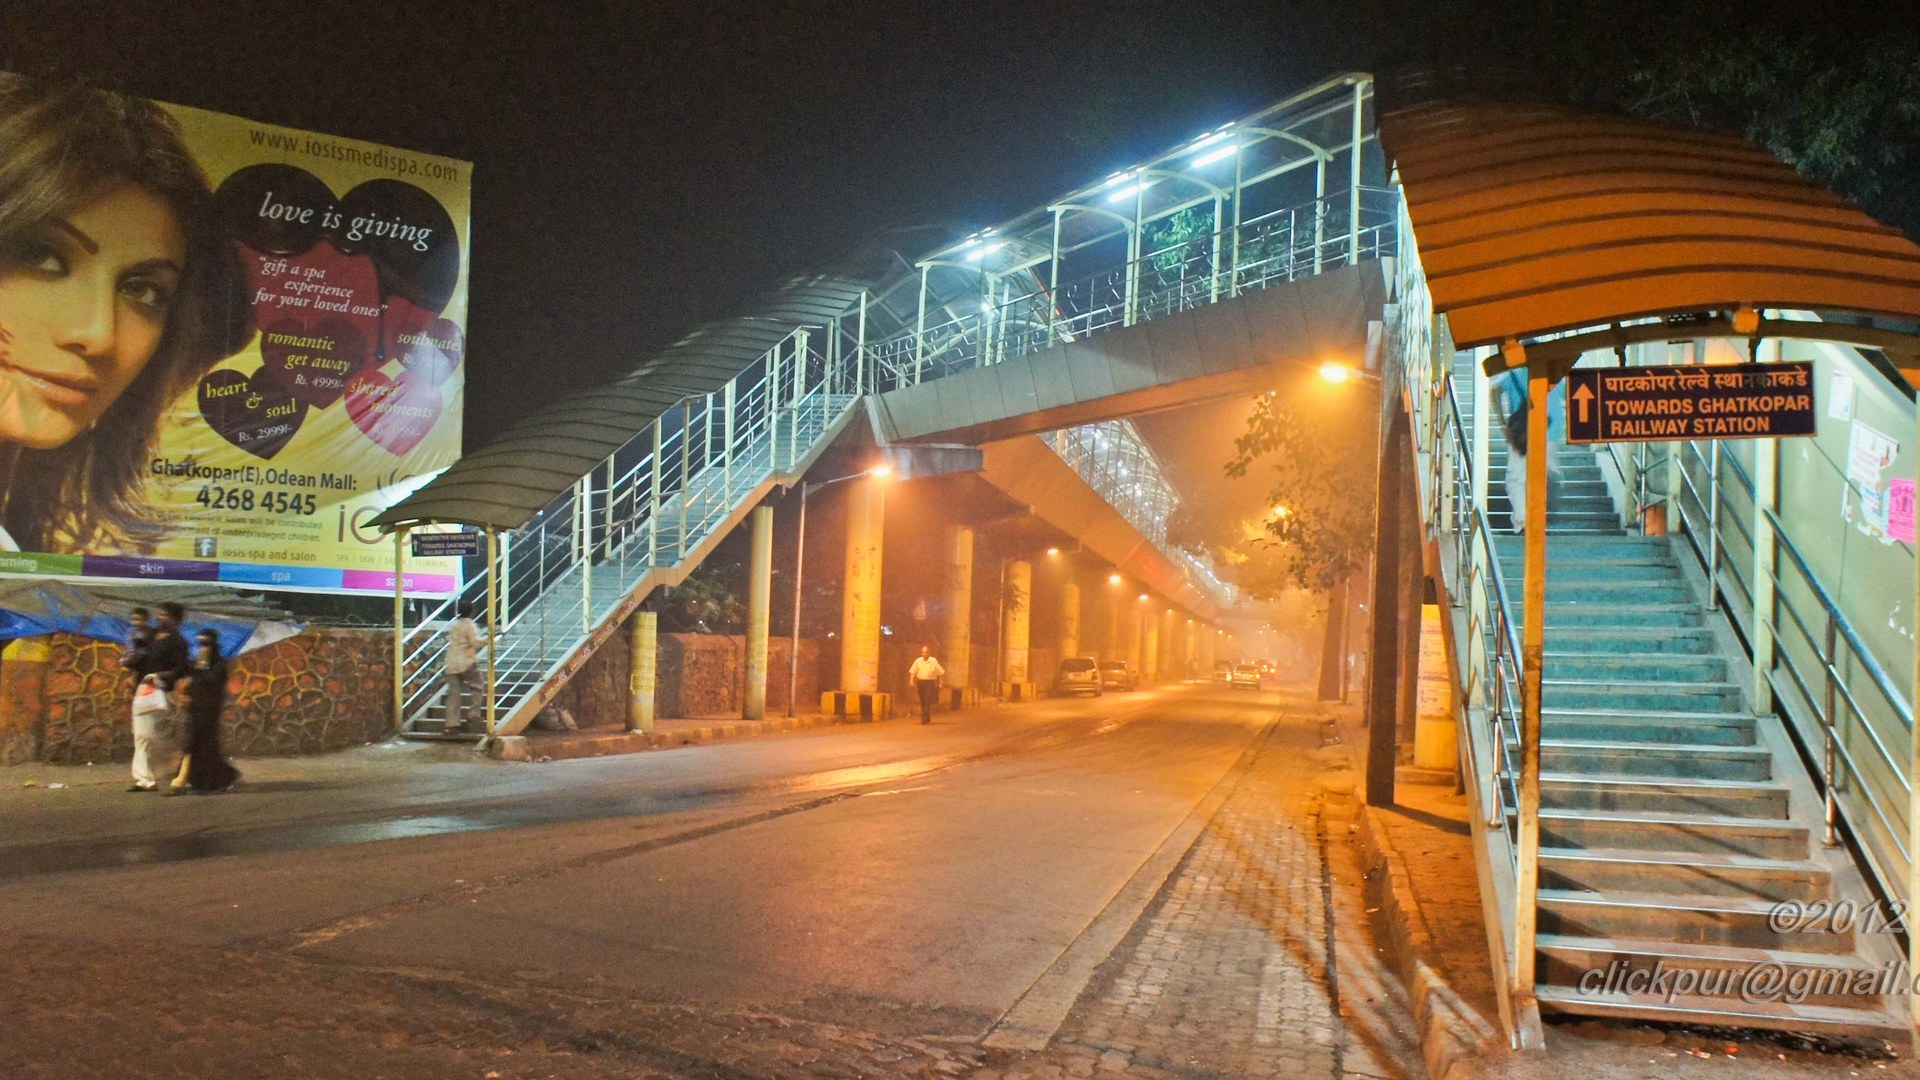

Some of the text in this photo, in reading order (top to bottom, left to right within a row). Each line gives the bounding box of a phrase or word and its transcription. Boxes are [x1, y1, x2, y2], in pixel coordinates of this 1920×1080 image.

[250, 130, 458, 182] www.iosismedispa.com
[259, 192, 432, 251] love is giving
[290, 266, 300, 275] a
[303, 267, 326, 281] spa
[284, 280, 354, 298] experience
[252, 287, 276, 305] for
[277, 294, 311, 308] your
[314, 296, 350, 313] loved
[267, 332, 335, 351] romantic
[284, 354, 350, 375] get away
[206, 382, 249, 399] heart
[1605, 370, 1676, 393] घाटकोपर
[246, 392, 263, 409] &
[266, 398, 297, 418] soul
[1605, 395, 1810, 417] TOWARDS GHATKOPAR
[1610, 416, 1770, 436] RAILWAY STATION
[238, 432, 253, 443] Rs.
[320, 473, 357, 491] Mall:
[196, 486, 316, 515] 4268 4545
[248, 550, 266, 561] spa
[269, 549, 288, 561] and
[290, 551, 317, 562] salon
[139, 563, 165, 575] skin
[271, 570, 291, 582] spa
[385, 577, 414, 588] saon
